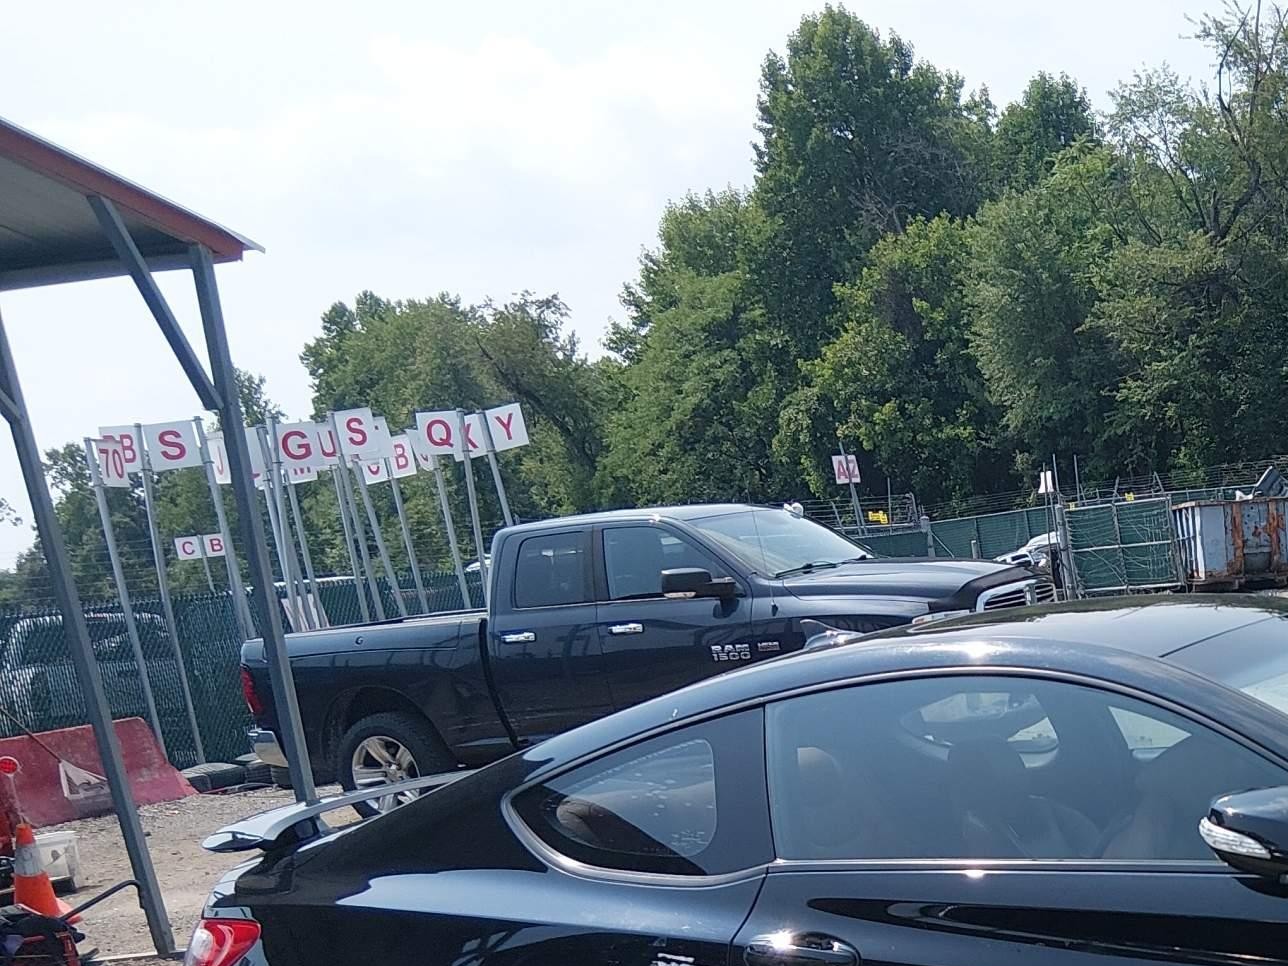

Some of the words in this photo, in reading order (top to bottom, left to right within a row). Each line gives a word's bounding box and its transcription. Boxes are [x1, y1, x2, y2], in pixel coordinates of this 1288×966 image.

[346, 417, 368, 446] S
[427, 419, 454, 448] Q
[494, 412, 513, 440] Y
[158, 430, 187, 460] S
[281, 430, 313, 460] G
[393, 443, 409, 471] B
[182, 541, 195, 556] C
[209, 538, 223, 553] B
[711, 643, 750, 653] RAM
[712, 651, 751, 662] 1500
